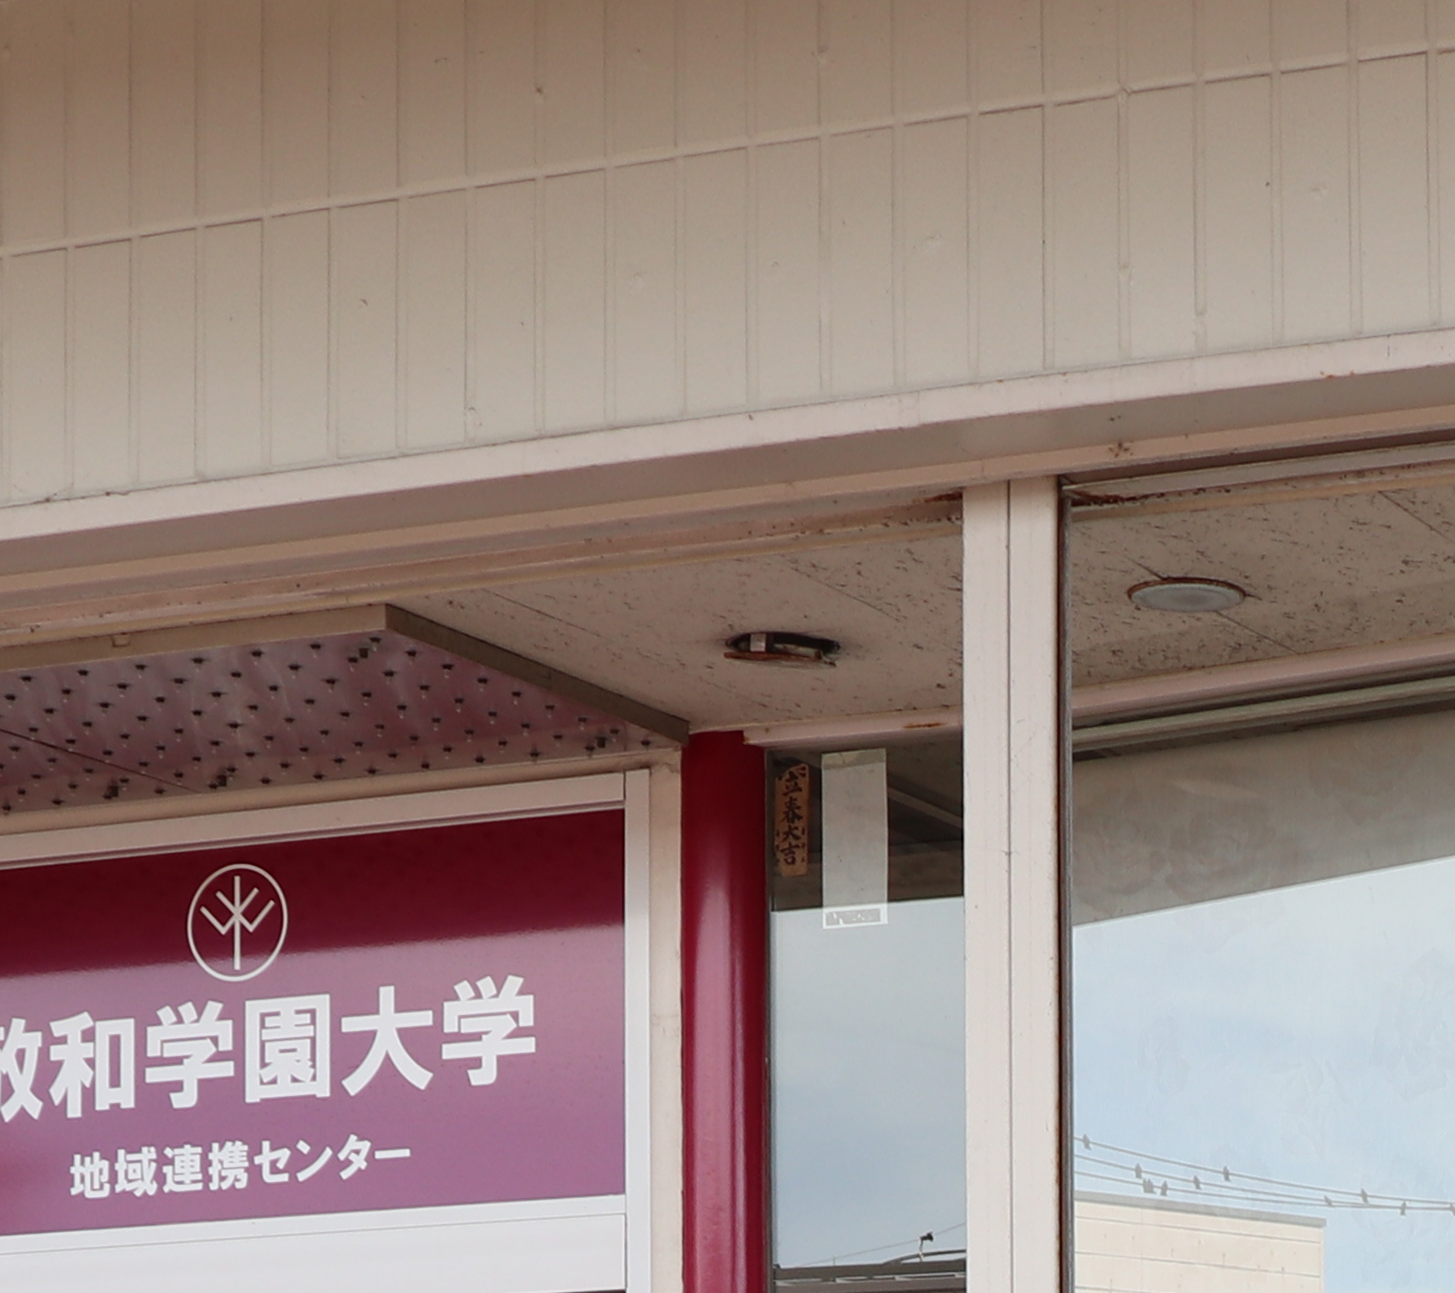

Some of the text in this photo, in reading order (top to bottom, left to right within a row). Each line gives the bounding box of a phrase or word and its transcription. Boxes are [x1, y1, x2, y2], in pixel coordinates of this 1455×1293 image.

[69, 1133, 412, 1200] 地域連携センター
